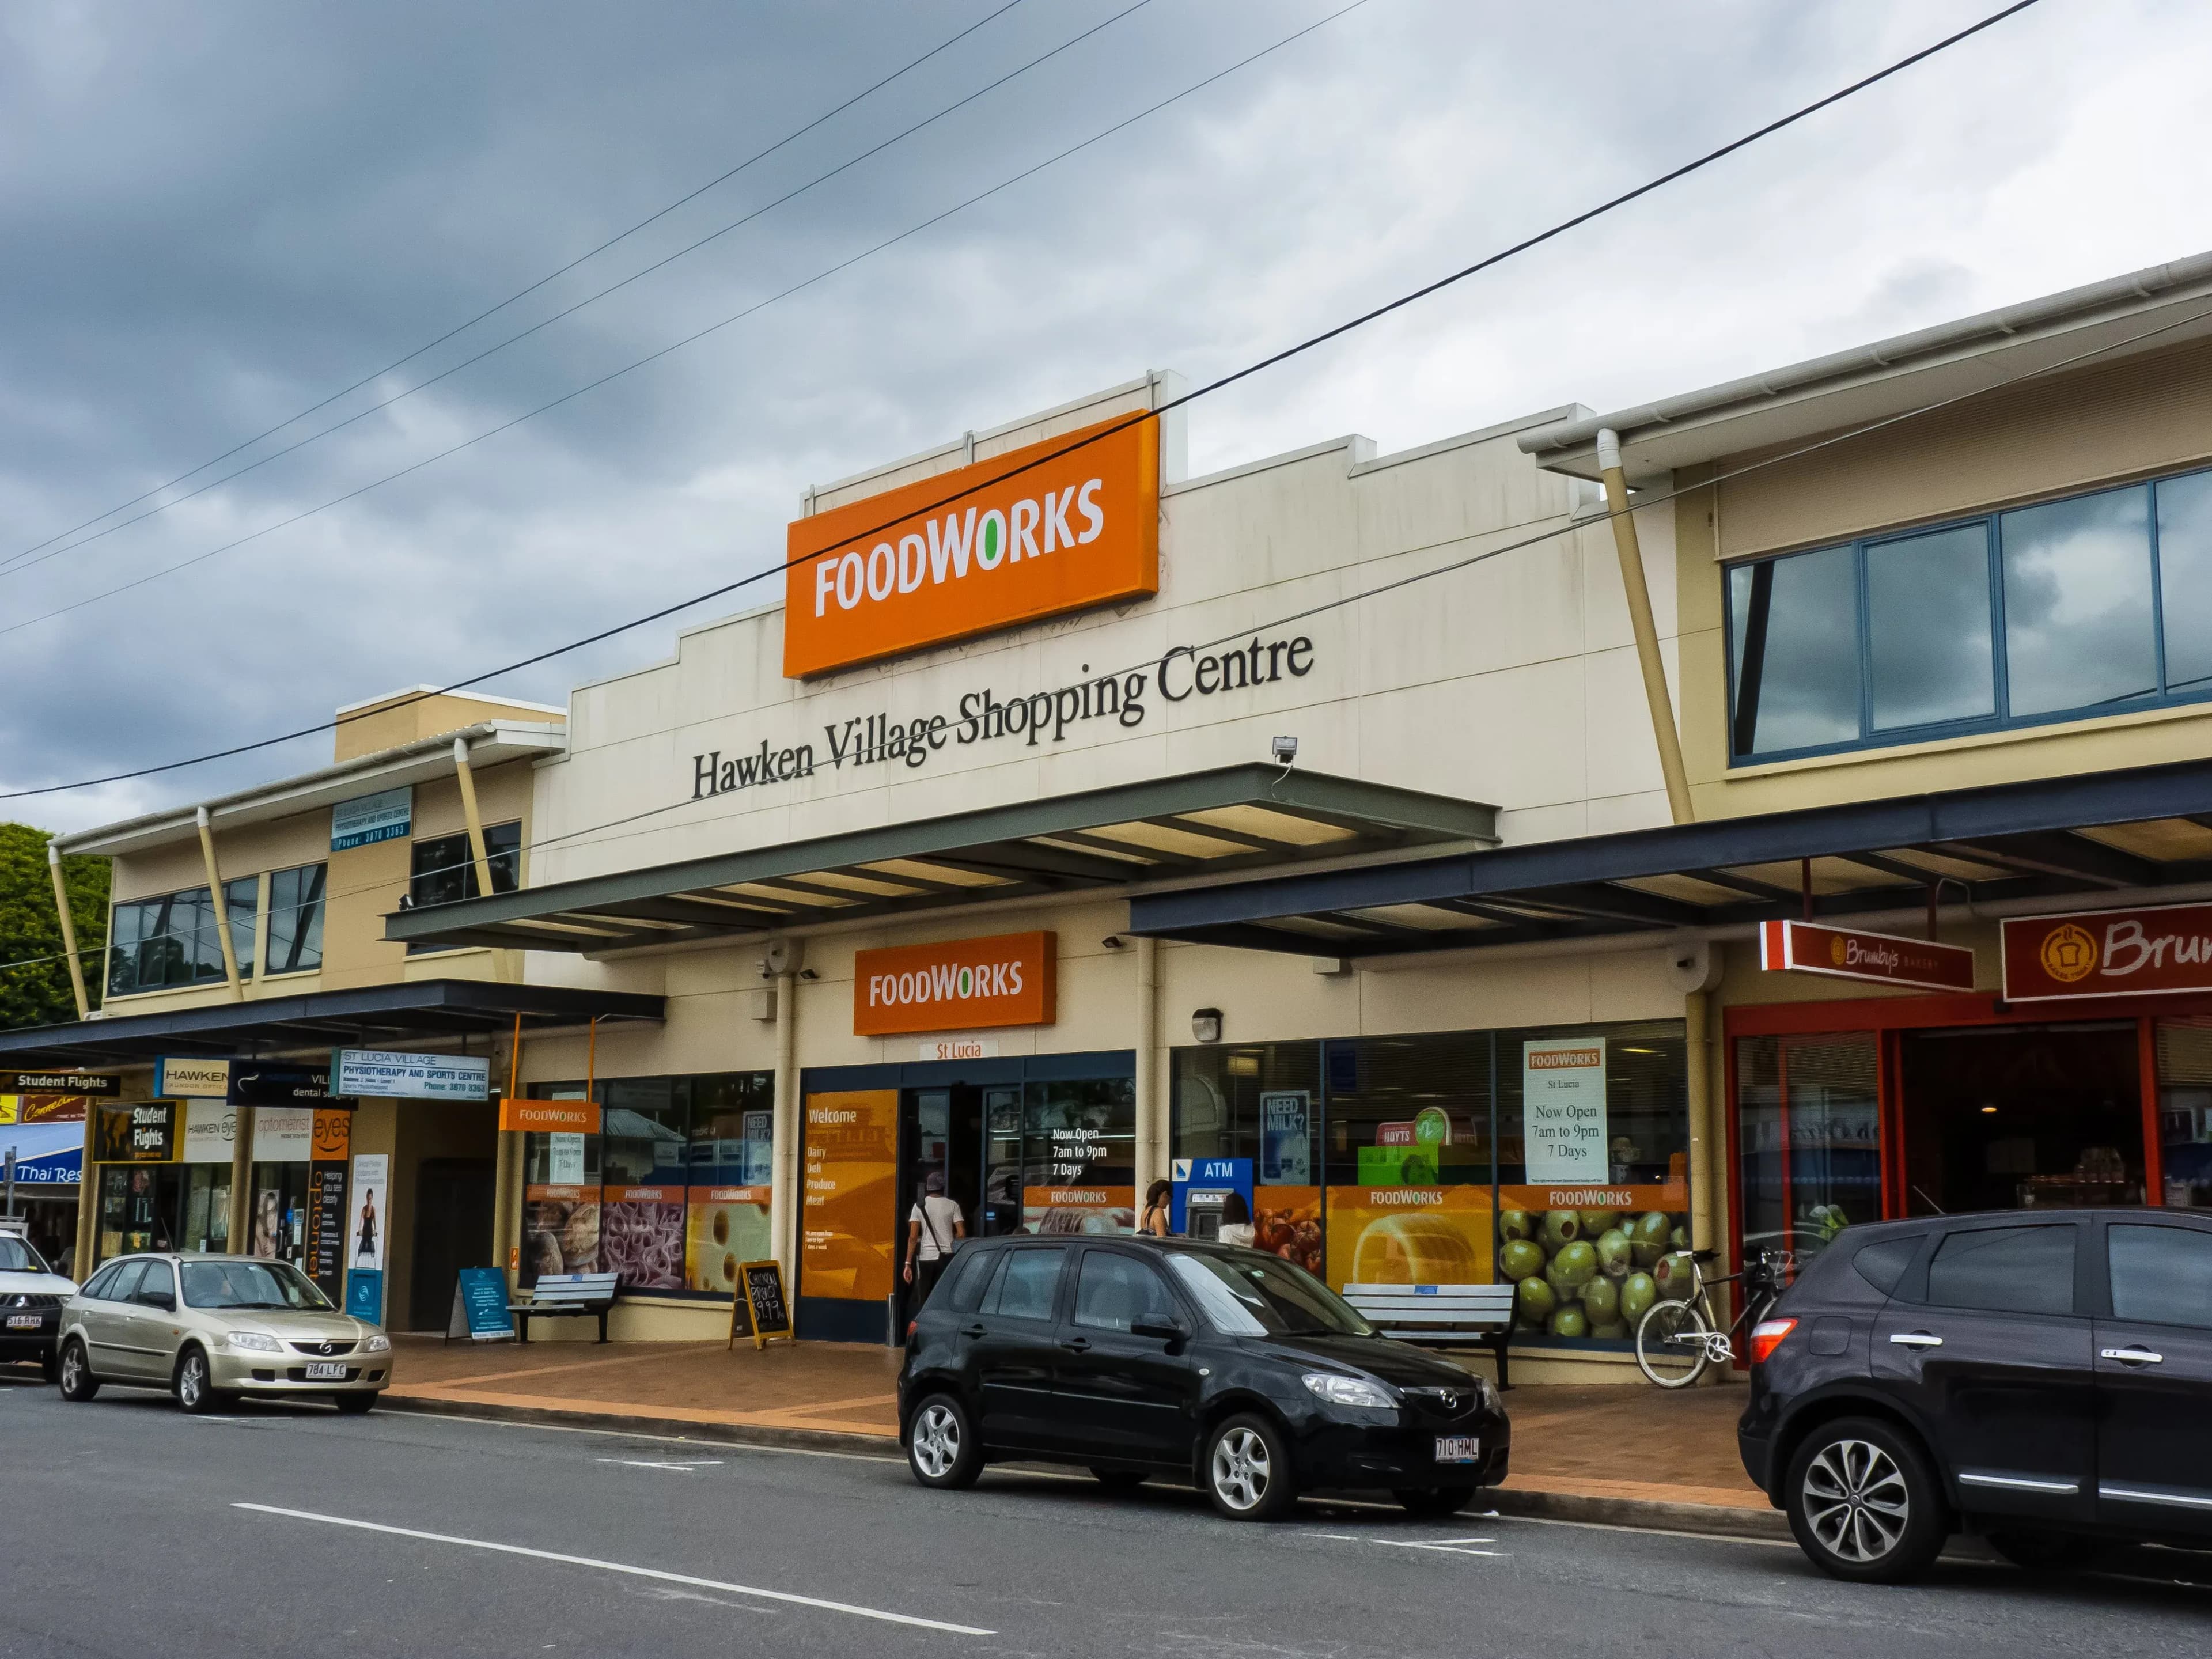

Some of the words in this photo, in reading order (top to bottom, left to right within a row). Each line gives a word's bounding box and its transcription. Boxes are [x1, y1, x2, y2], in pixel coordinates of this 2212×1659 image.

[815, 479, 1104, 618] FOODWORKS
[692, 739, 814, 799] Hawken
[824, 712, 948, 769] Village
[957, 664, 1148, 746] Shopping
[1158, 636, 1315, 702] Centre
[1846, 939, 1899, 974] Brumby's
[870, 961, 1023, 1007] FOODWORKS
[937, 1043, 948, 1059] St
[952, 1041, 982, 1058] Lucia
[345, 1051, 357, 1060] ST
[361, 1053, 391, 1062] LUCIA
[395, 1055, 437, 1065] VILLAGE
[1531, 1052, 1598, 1067] FOODWORKS
[343, 1066, 407, 1077] PHYSIOTHERAPY
[408, 1069, 425, 1078] AND
[427, 1070, 456, 1080] SPORTS
[458, 1071, 486, 1081] CENTRE
[18, 1075, 66, 1087] Student
[67, 1075, 108, 1089] Flights
[424, 1082, 447, 1090] Phone:
[1548, 1080, 1556, 1089] St
[1558, 1080, 1580, 1088] Lucia
[293, 1088, 321, 1097] dental
[1267, 1097, 1298, 1115] NEED
[1536, 1105, 1563, 1118] Now
[1566, 1105, 1597, 1120] Open
[133, 1107, 167, 1124] Student
[520, 1109, 587, 1123] FOODWORKS
[809, 1107, 857, 1124] Welcome
[1267, 1113, 1305, 1131] MILK?
[188, 1123, 220, 1135] HAWKEN
[259, 1116, 310, 1139] optometrist
[313, 1116, 351, 1143] eyes
[1532, 1125, 1555, 1138] 7am
[1559, 1126, 1570, 1138] to
[1574, 1124, 1599, 1140] 9pm
[134, 1128, 164, 1150] Flights
[567, 1135, 581, 1144] Open
[1053, 1128, 1073, 1141] Now
[1075, 1128, 1099, 1143] Open
[1384, 1130, 1410, 1143] HOYTS
[807, 1146, 827, 1160] Dairy
[1053, 1146, 1073, 1157] 7am
[1075, 1146, 1084, 1157] to
[1087, 1145, 1107, 1160] 9pm
[1548, 1145, 1554, 1157] 7
[1558, 1144, 1587, 1160] Days
[17, 1165, 52, 1180] Thai
[807, 1162, 821, 1174] Deli
[1053, 1164, 1059, 1175] 7
[1061, 1164, 1082, 1178] Days
[1204, 1162, 1233, 1177] ATM
[806, 1179, 836, 1190] Produce
[546, 1188, 581, 1198] FOODWORKS
[624, 1188, 662, 1200] FOODWORKS
[710, 1188, 752, 1200] FOODWORKS
[806, 1195, 824, 1206] Meat
[1051, 1190, 1107, 1203] FOODWORKS
[1370, 1190, 1443, 1205] FOODWORKS
[1550, 1189, 1632, 1206] FOODWORKS
